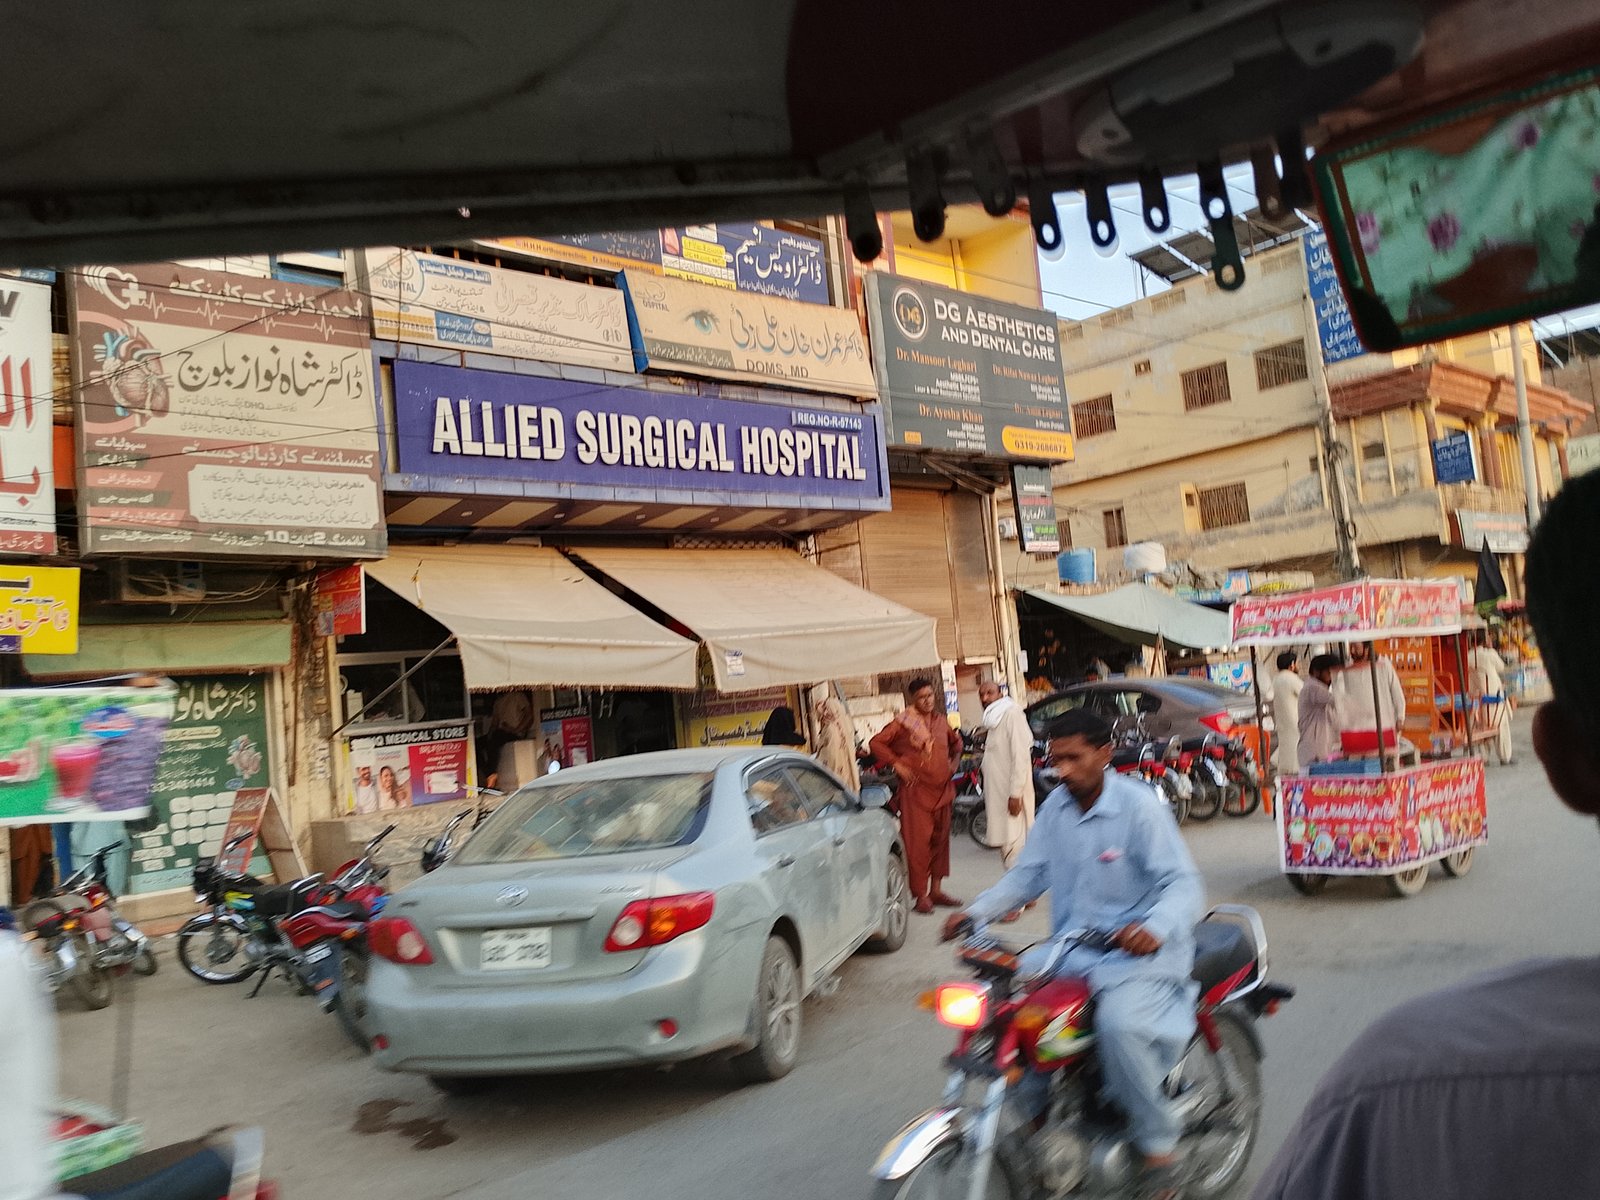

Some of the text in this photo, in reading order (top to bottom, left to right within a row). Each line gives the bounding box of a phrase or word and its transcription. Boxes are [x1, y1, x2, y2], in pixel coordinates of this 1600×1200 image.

[934, 298, 1055, 343] DG AESTHETICS
[942, 326, 1056, 362] AND DENTAL CARE
[896, 346, 909, 361] Dr.
[177, 341, 363, 408] ڈاکٹر شاہ نواز بلوچ
[790, 366, 809, 378] MD
[244, 401, 265, 410] DHQ
[919, 403, 932, 417] Dr.
[432, 396, 867, 481] ALLIED SURGICAL HOSPITAL
[264, 530, 289, 543] 10
[314, 532, 327, 544] 2
[223, 682, 257, 719] ڈاکٹر
[385, 730, 431, 745] MEDICAL
[432, 727, 465, 740] STORE
